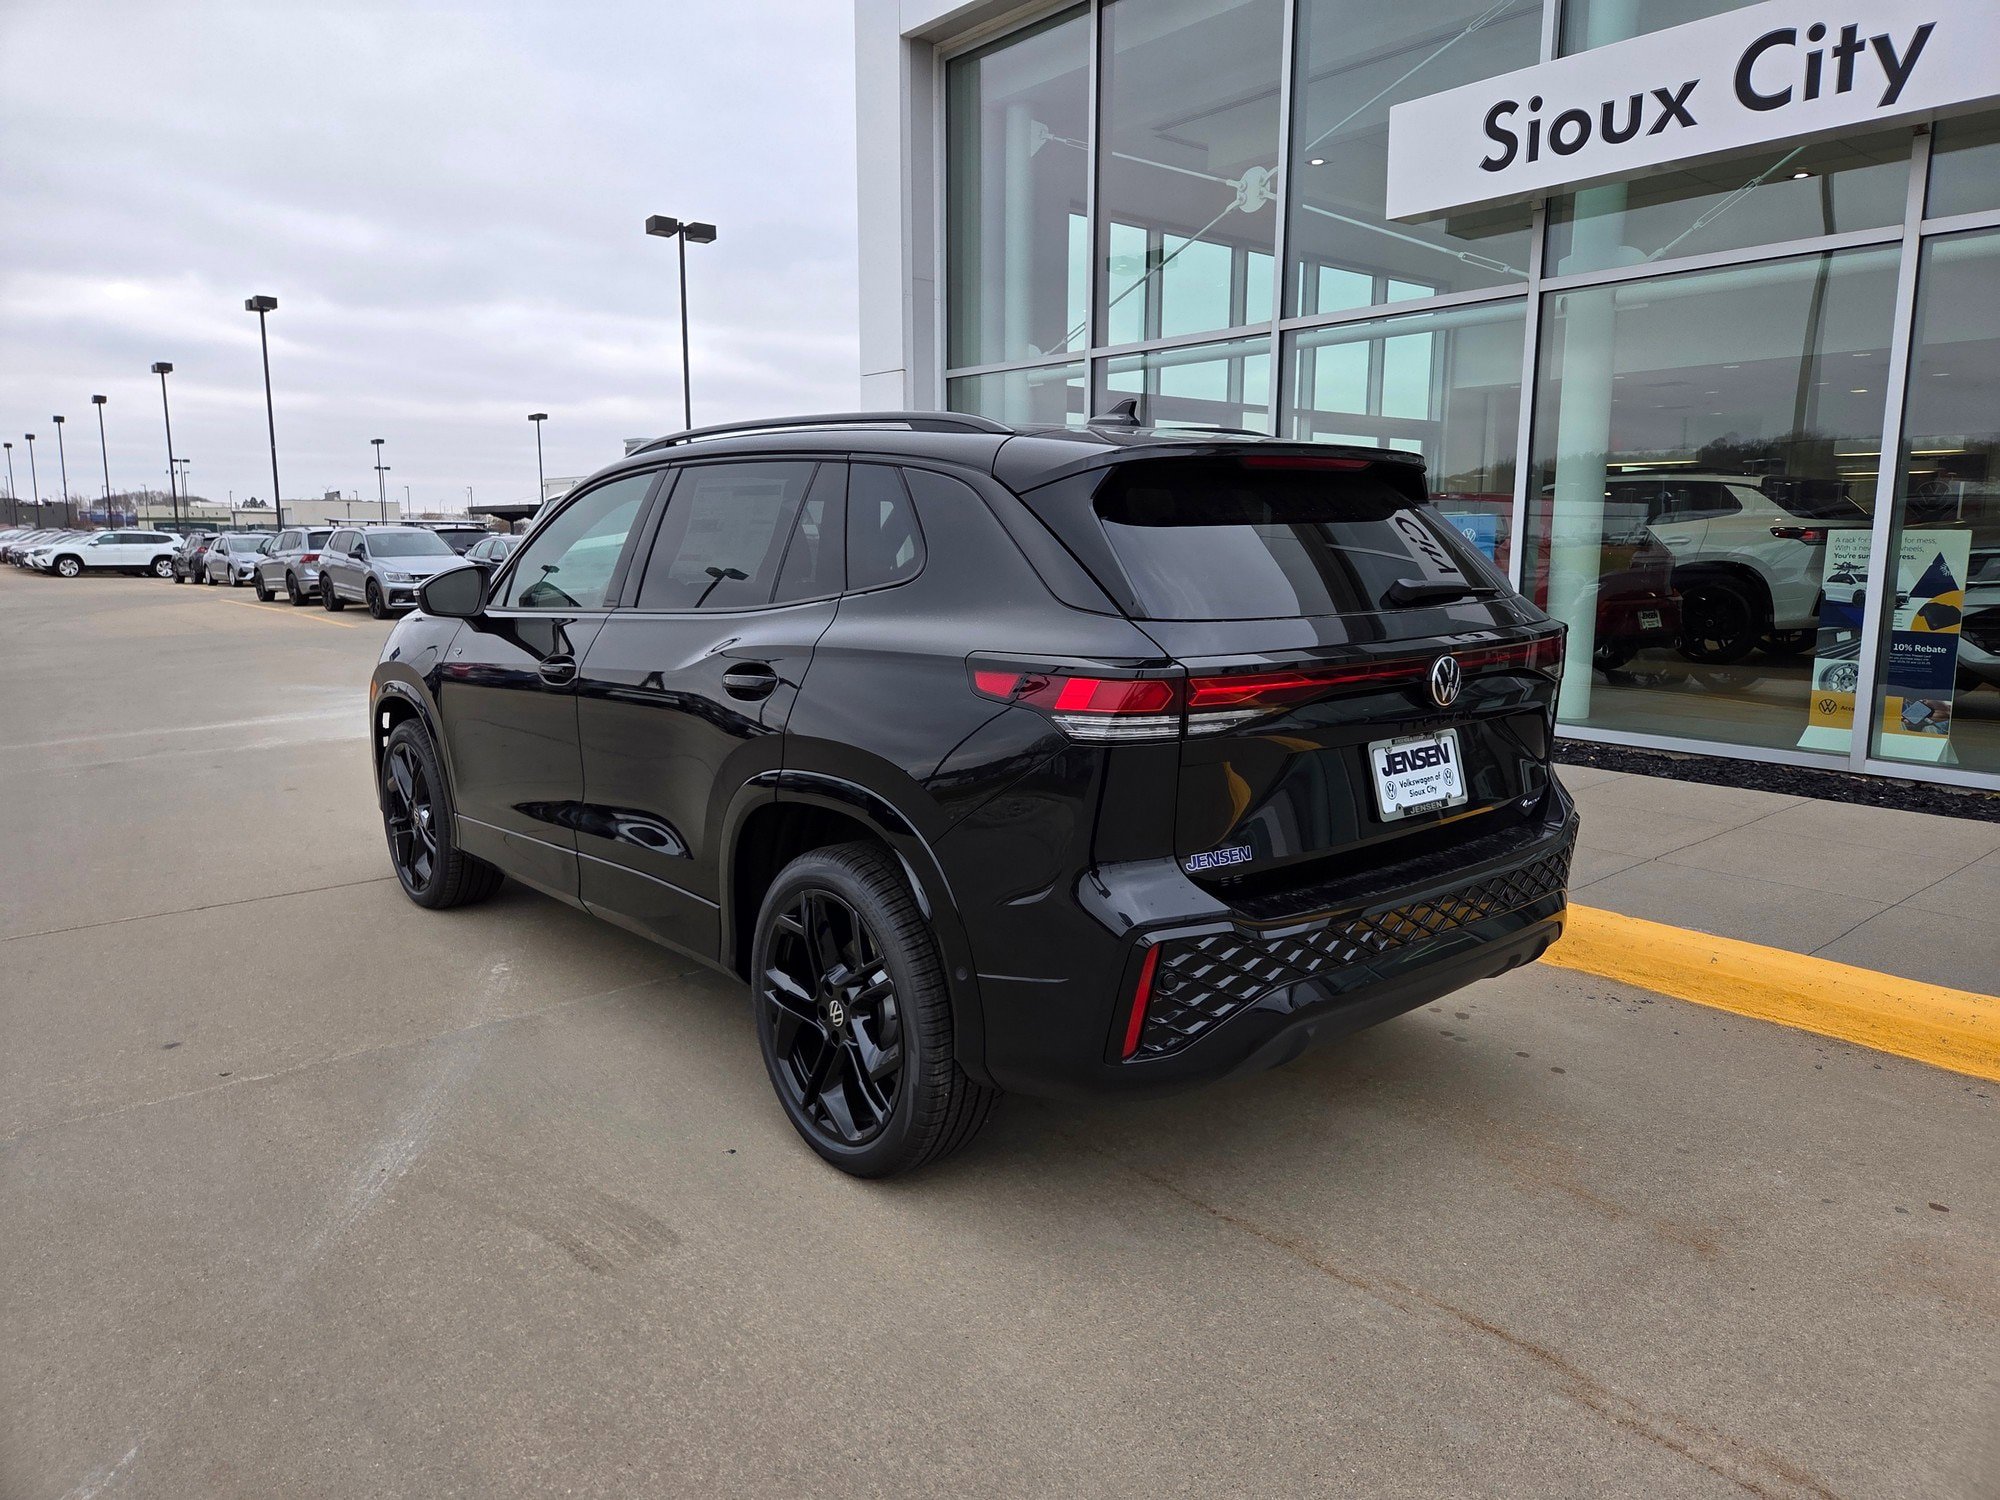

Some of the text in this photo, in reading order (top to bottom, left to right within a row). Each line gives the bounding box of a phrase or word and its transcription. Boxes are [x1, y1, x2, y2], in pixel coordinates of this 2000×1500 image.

[1479, 21, 1937, 173] Sioux City
[1893, 643, 1947, 654] 10% Rebate
[1382, 743, 1451, 777] JENSEN
[1398, 771, 1442, 788] Volkswagen of
[1409, 785, 1438, 798] Sioux City
[1410, 801, 1443, 815] JENSEN
[1186, 845, 1253, 872] JENSEN
